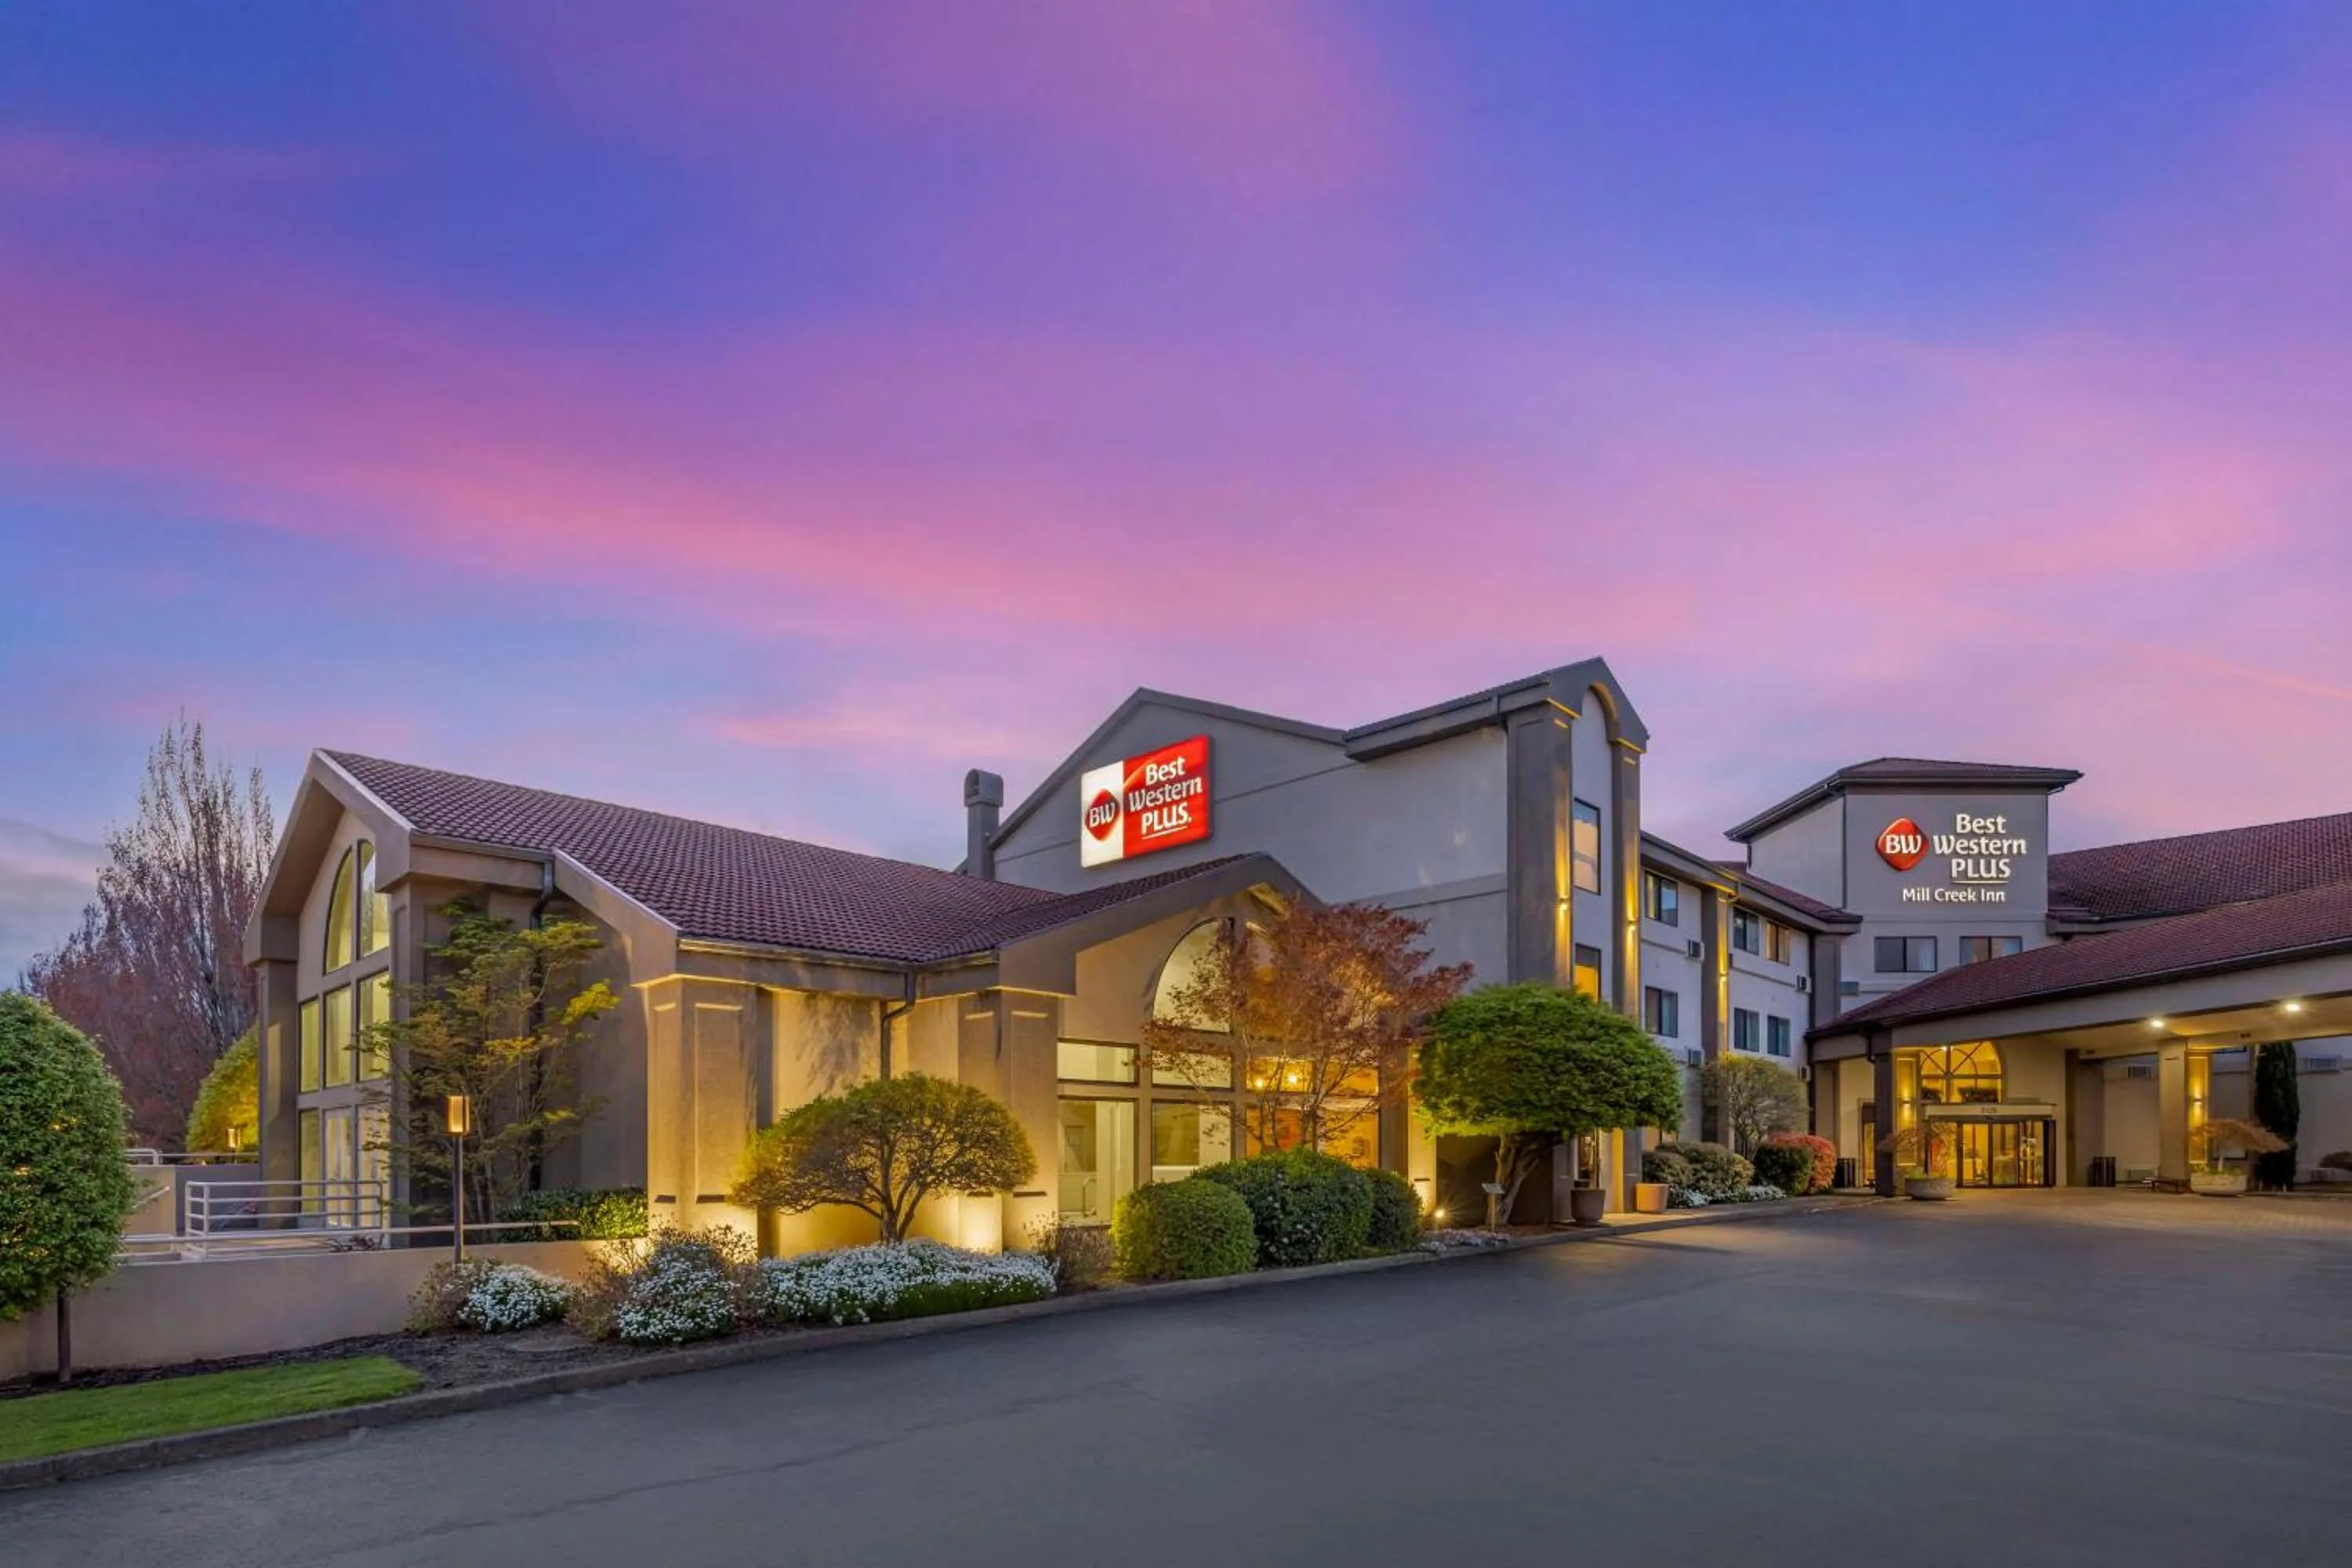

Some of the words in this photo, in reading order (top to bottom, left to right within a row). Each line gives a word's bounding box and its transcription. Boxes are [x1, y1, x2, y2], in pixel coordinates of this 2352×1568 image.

[1145, 756, 1186, 786] Best
[1129, 777, 1202, 812] Western
[1089, 802, 1116, 828] BW
[1955, 813, 2006, 833] Best
[1886, 834, 1922, 854] BW
[1933, 834, 2027, 855] Western
[1951, 858, 2012, 878] PLUS
[1903, 887, 1929, 902] Mill
[1934, 887, 1976, 902] Creek
[1981, 888, 2005, 902] Inn
